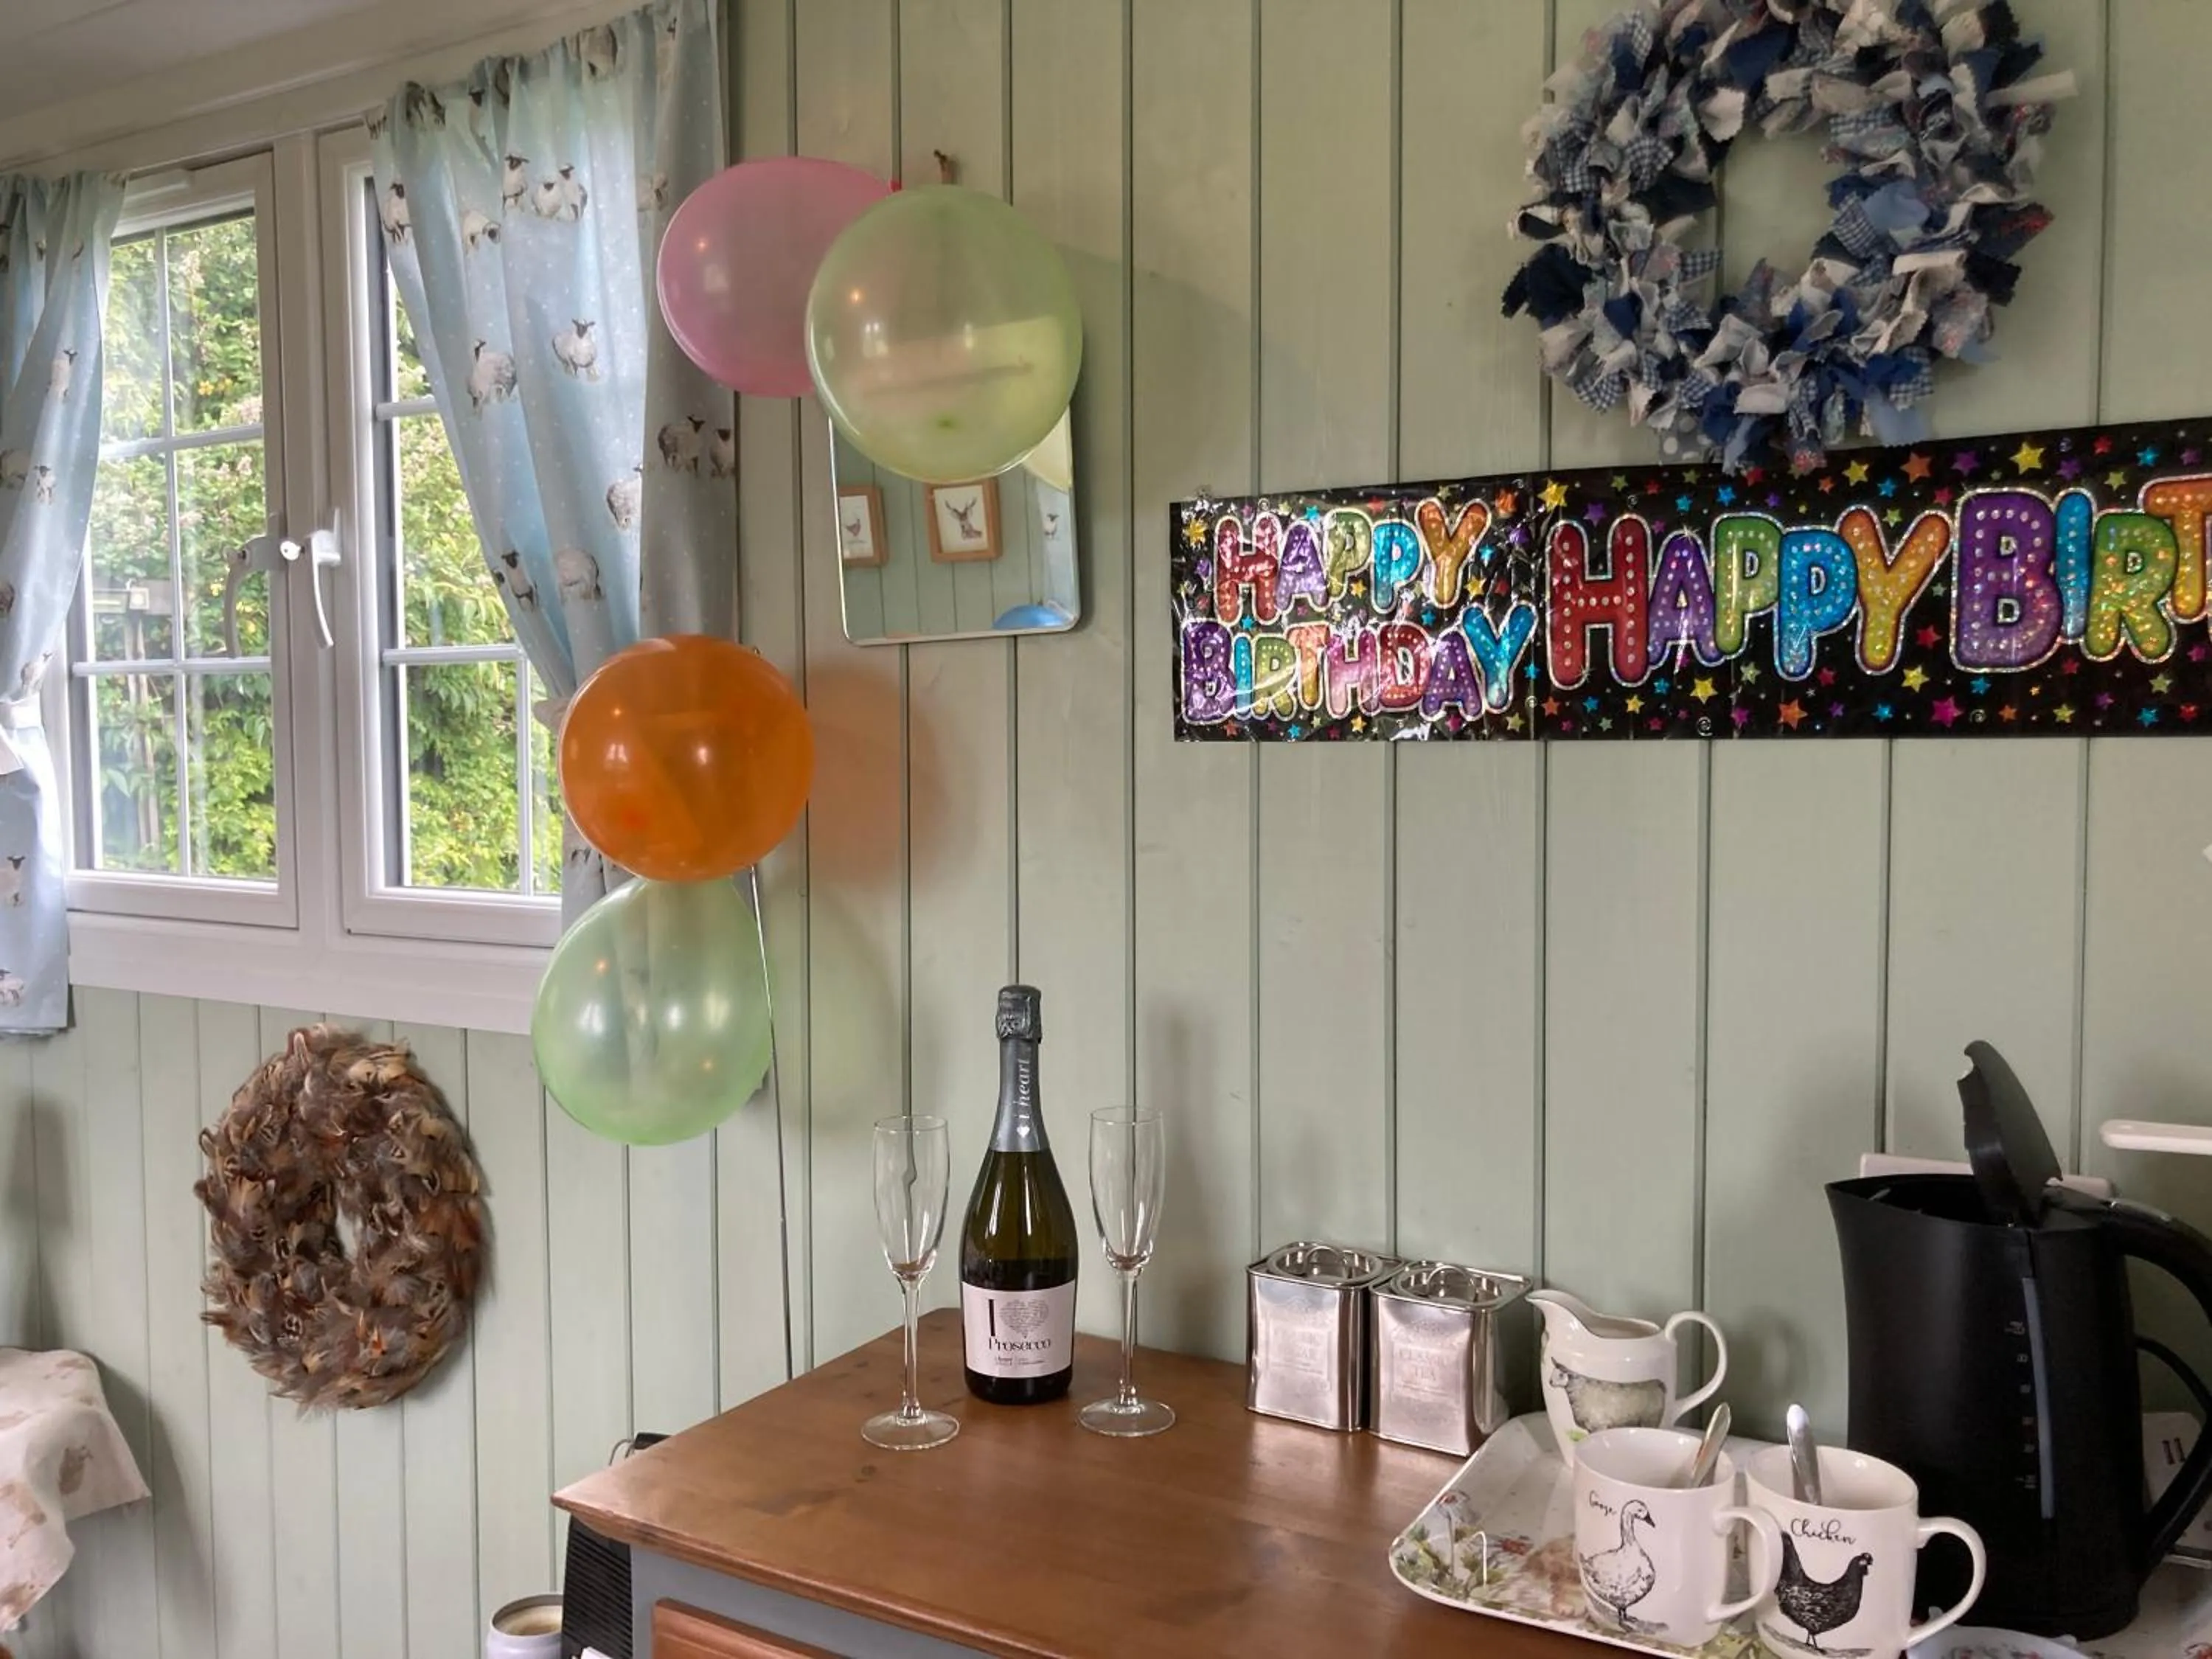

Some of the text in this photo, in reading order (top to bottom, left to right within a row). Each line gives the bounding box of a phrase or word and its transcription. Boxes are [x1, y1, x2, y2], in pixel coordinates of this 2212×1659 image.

[1213, 497, 1492, 625] HAPPY
[1546, 473, 2212, 689] HAPPY BIRT
[1181, 599, 1538, 723] BIRTHDAY
[1013, 1059, 1031, 1107] heart
[989, 1337, 1051, 1351] Prosecco
[1790, 1518, 1857, 1545] Chicken
